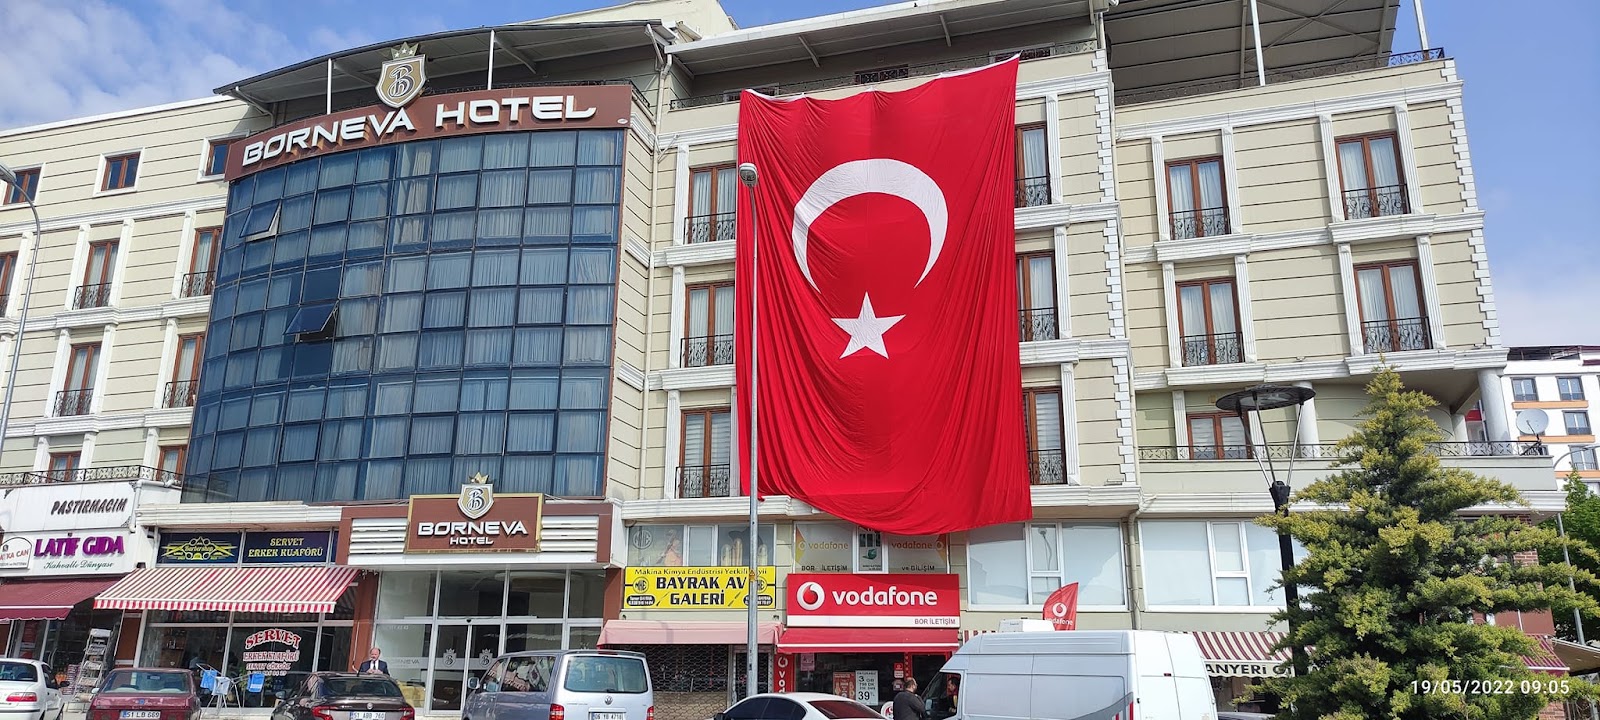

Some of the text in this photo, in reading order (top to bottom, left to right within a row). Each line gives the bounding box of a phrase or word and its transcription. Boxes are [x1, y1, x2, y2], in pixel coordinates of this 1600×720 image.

[242, 95, 597, 166] BORNEVA HOTEL
[51, 497, 128, 515] PASTIRMACIM
[418, 520, 529, 536] BORNEVA
[82, 535, 125, 556] GIDA
[270, 537, 304, 546] SERVET
[450, 537, 494, 546] HOTEL
[808, 541, 849, 550] vodafone
[891, 541, 932, 550] vodafone
[248, 547, 323, 557] ERKEK KUAFÖRÜ
[663, 568, 686, 576] Kimya
[656, 577, 720, 589] BAYRAK
[726, 577, 747, 589] AV
[670, 590, 725, 605] GALERİ
[832, 586, 938, 606] vodafone
[929, 617, 956, 626] İLETİŞİM
[245, 628, 302, 650] SERVET
[858, 691, 870, 700] 39
